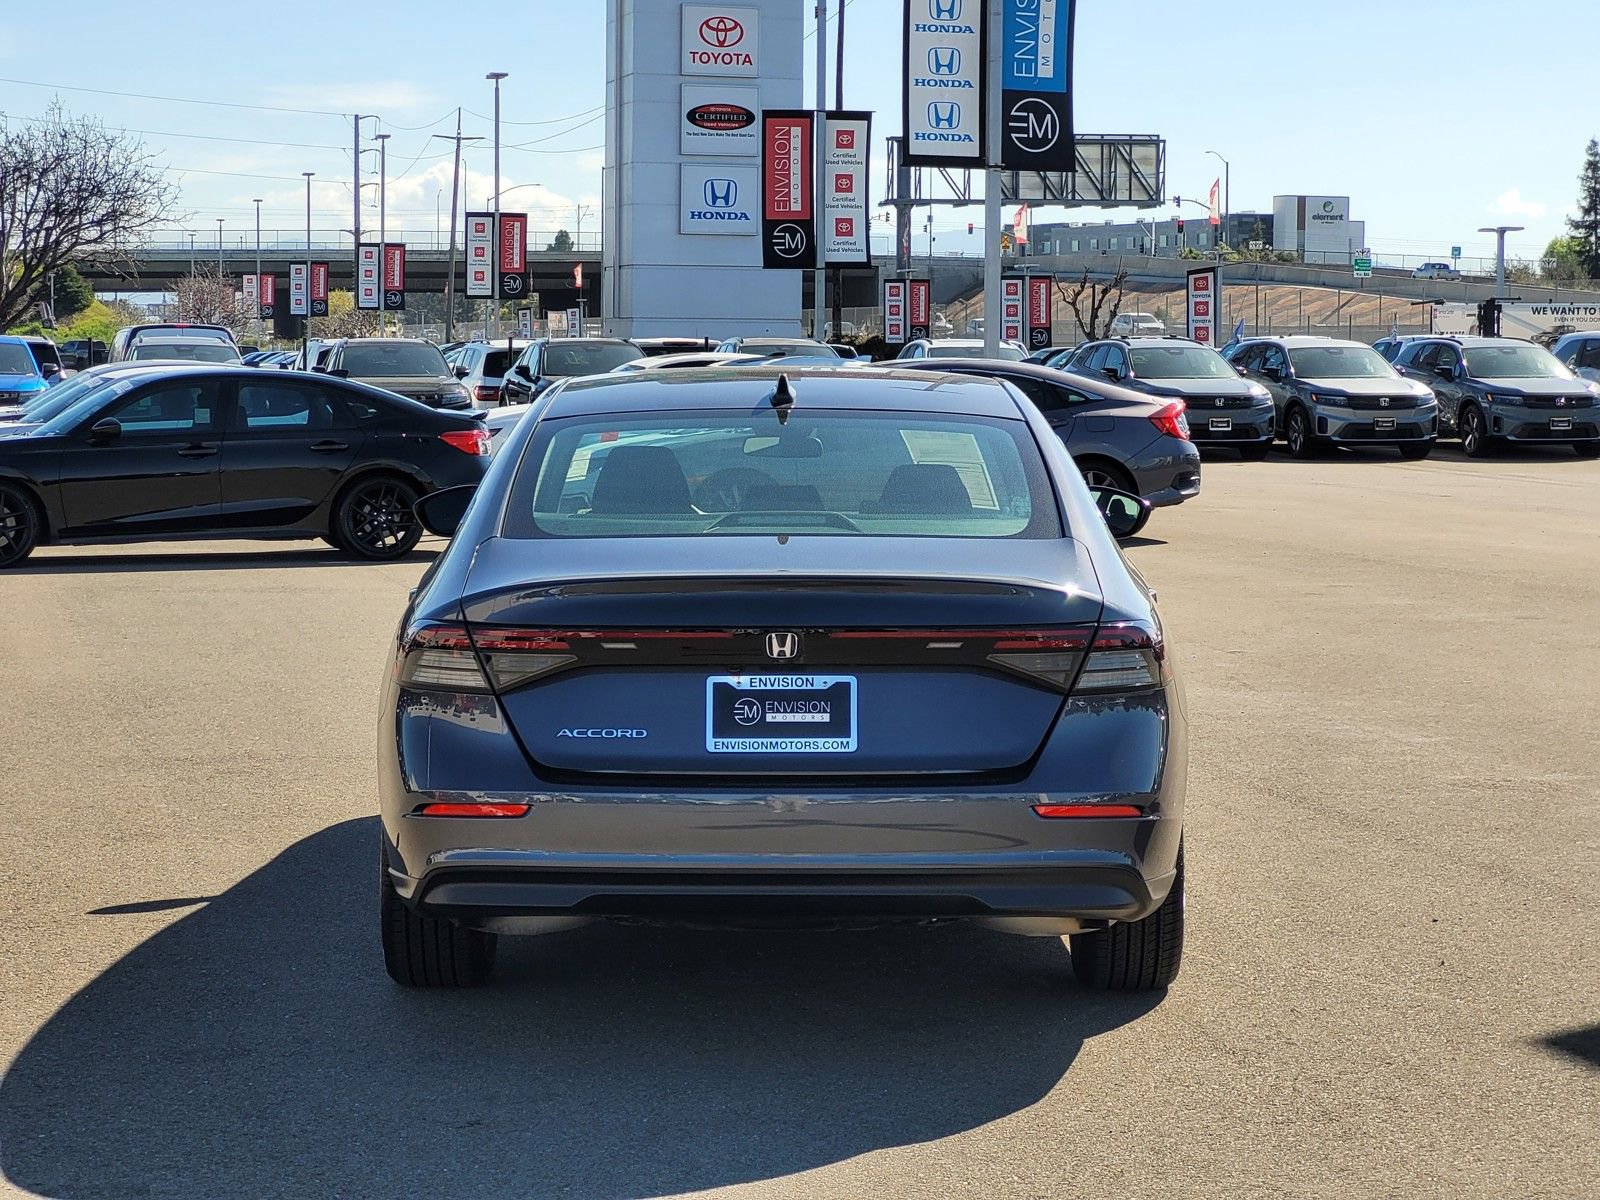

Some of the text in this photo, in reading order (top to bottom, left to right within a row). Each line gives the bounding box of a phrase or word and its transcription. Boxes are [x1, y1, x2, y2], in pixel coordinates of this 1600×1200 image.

[914, 23, 975, 34] HONDA
[689, 51, 753, 66] TOYOTA
[913, 78, 975, 89] HONDA
[695, 112, 747, 121] CERTIFIED
[913, 132, 975, 143] HONDA
[774, 126, 790, 212] ENVISION
[792, 134, 800, 205] MOTORS
[690, 211, 751, 221] HONDA
[1312, 213, 1344, 221] element
[504, 221, 514, 269] ENVISION
[1032, 282, 1040, 324] ENVISION
[1531, 306, 1597, 315] WE WANT TO
[750, 677, 815, 688] ENVISION
[765, 701, 830, 713] ENVISION
[557, 728, 648, 739] ACCORD
[713, 741, 850, 750] ENVISIONMOTORS.COM
